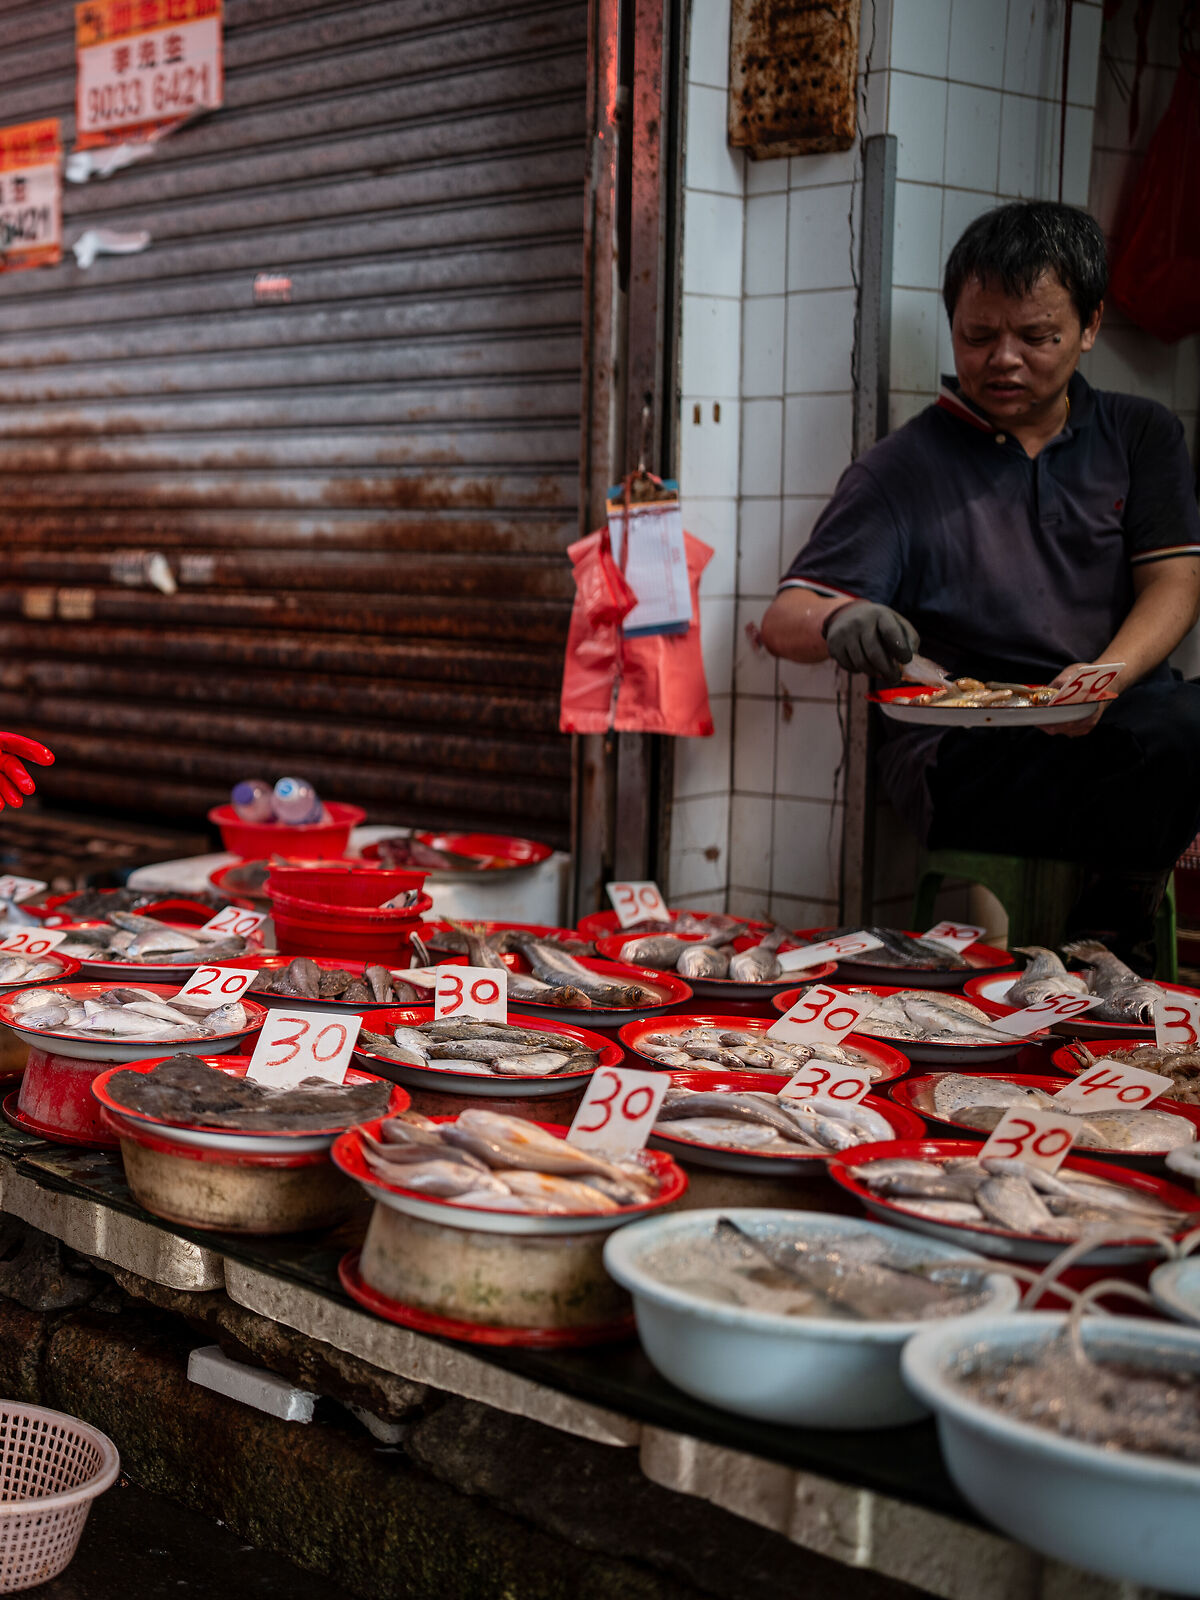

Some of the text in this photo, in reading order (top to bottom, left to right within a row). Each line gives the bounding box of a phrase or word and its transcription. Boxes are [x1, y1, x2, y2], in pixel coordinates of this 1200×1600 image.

[1053, 670, 1118, 704] 50
[614, 884, 660, 919] 30
[208, 908, 260, 934] 20
[0, 934, 51, 955] 20
[184, 968, 247, 995] 20
[438, 974, 499, 1015] 30
[788, 989, 860, 1031] 30
[1025, 994, 1091, 1015] 50
[265, 1017, 347, 1067] 30
[1163, 1006, 1200, 1046] 3
[784, 1067, 865, 1100] 30
[1079, 1069, 1152, 1103] 40
[576, 1071, 655, 1133] 30
[983, 1118, 1072, 1159] 30
